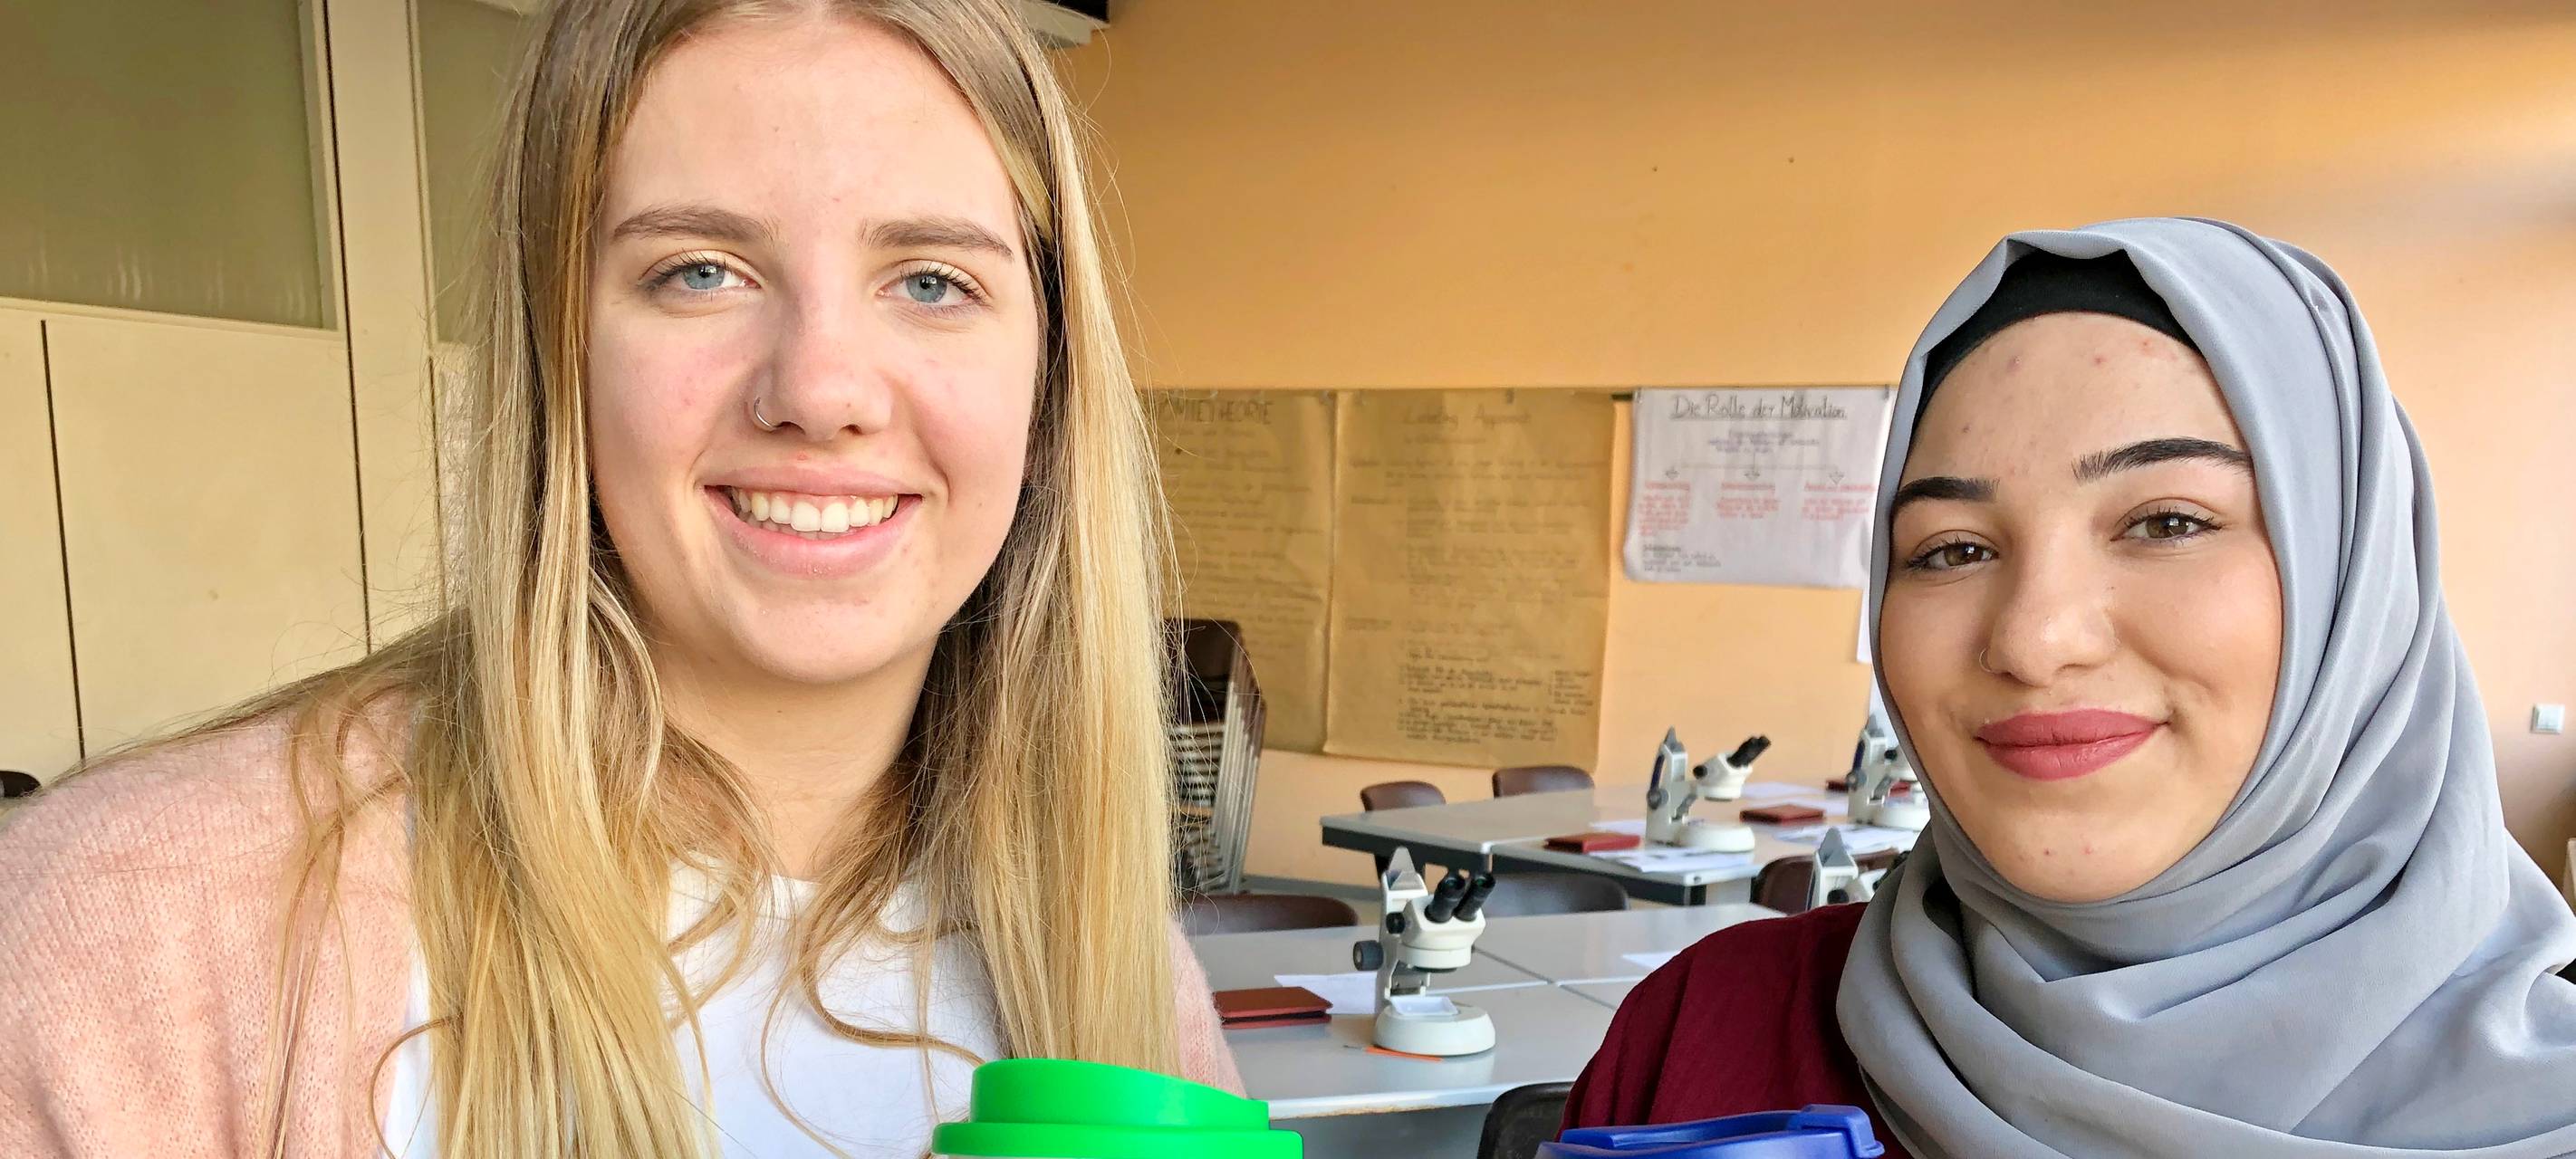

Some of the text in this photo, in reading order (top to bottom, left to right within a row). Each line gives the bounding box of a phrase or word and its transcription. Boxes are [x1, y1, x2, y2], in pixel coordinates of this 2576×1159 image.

[1672, 393, 1699, 418] Die
[1706, 393, 1745, 417] Rolle
[1753, 398, 1775, 418] der
